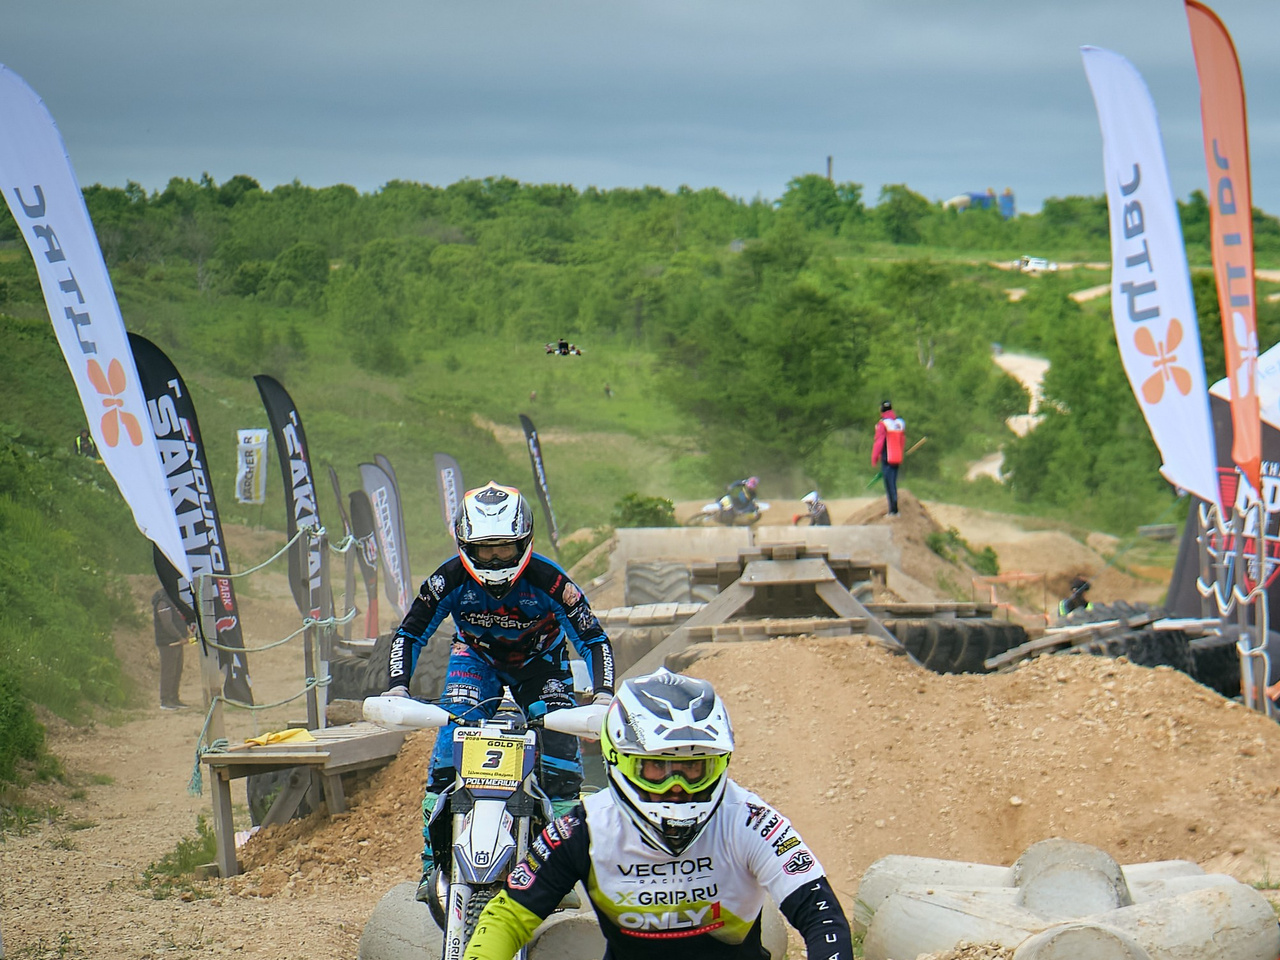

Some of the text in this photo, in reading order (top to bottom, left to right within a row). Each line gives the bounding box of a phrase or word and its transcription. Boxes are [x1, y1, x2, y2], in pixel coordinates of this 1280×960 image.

[216, 577, 233, 606] PARK
[389, 636, 405, 678] ENDURO
[487, 740, 514, 748] GOLD
[481, 750, 504, 769] 3
[465, 778, 518, 787] POLYMERIUM
[616, 856, 715, 878] VECTOR
[639, 876, 694, 885] RACING
[615, 883, 719, 906] X-GRIP.RU
[617, 901, 721, 931] ONLY1
